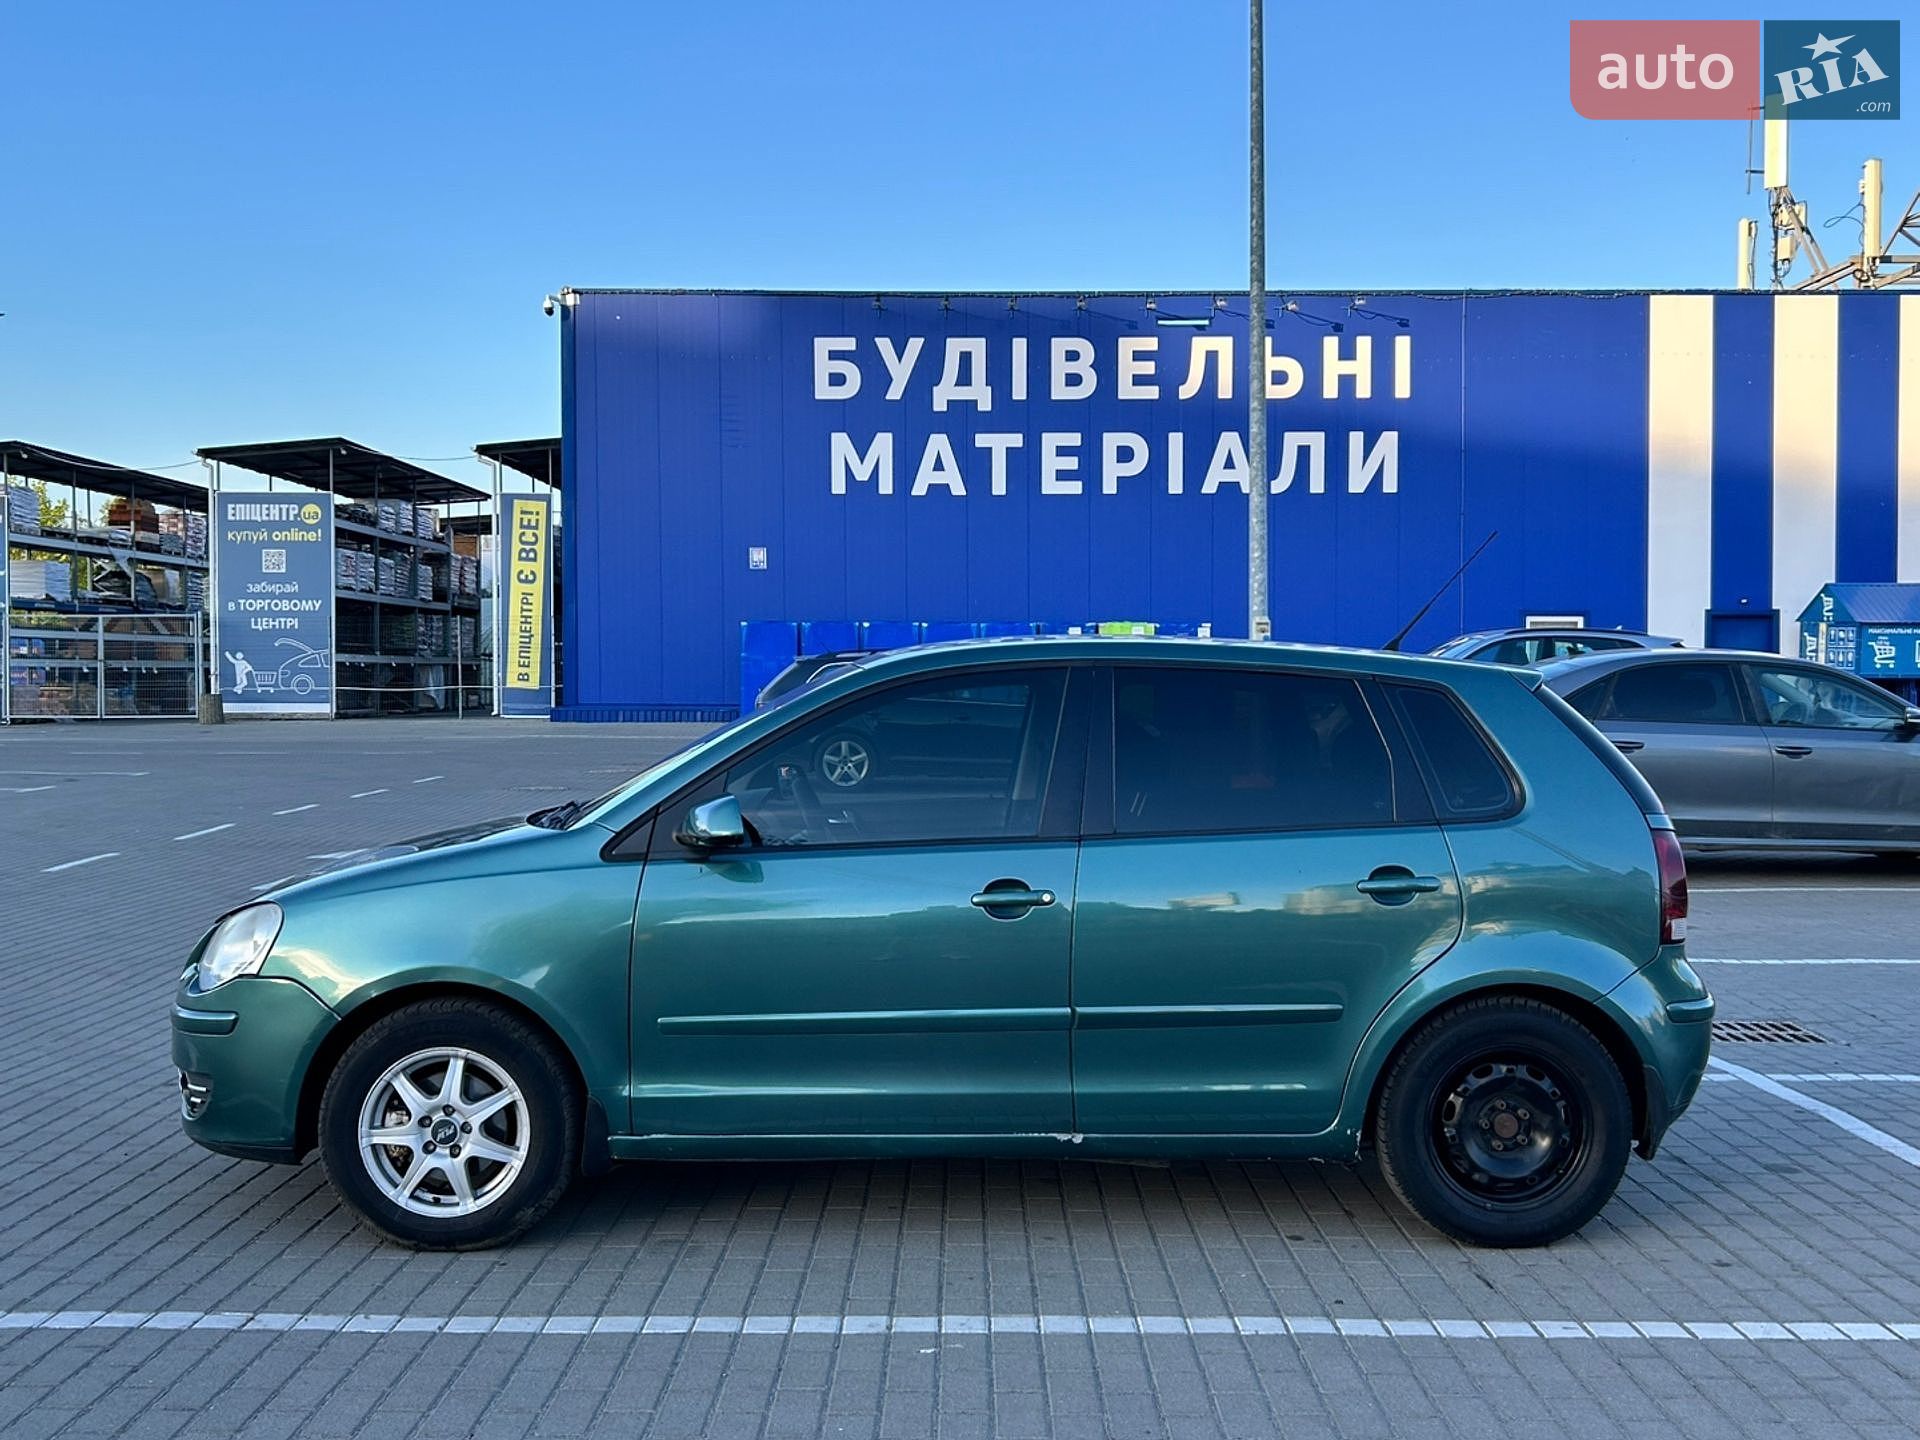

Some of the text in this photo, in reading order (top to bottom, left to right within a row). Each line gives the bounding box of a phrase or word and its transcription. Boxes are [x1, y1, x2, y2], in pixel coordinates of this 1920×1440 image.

[813, 335, 1412, 412] БУДІВЕЛЬНІ
[830, 430, 1400, 496] МАТЕРІАЛИ
[227, 528, 322, 544] купуй online!
[246, 581, 299, 595] забирай
[517, 508, 540, 682] В ЕПІЦЕНТРІ Є ВСЕ!
[228, 599, 322, 611] в ТОРГОВОМУ
[250, 617, 299, 631] ЦЕНТРІ
